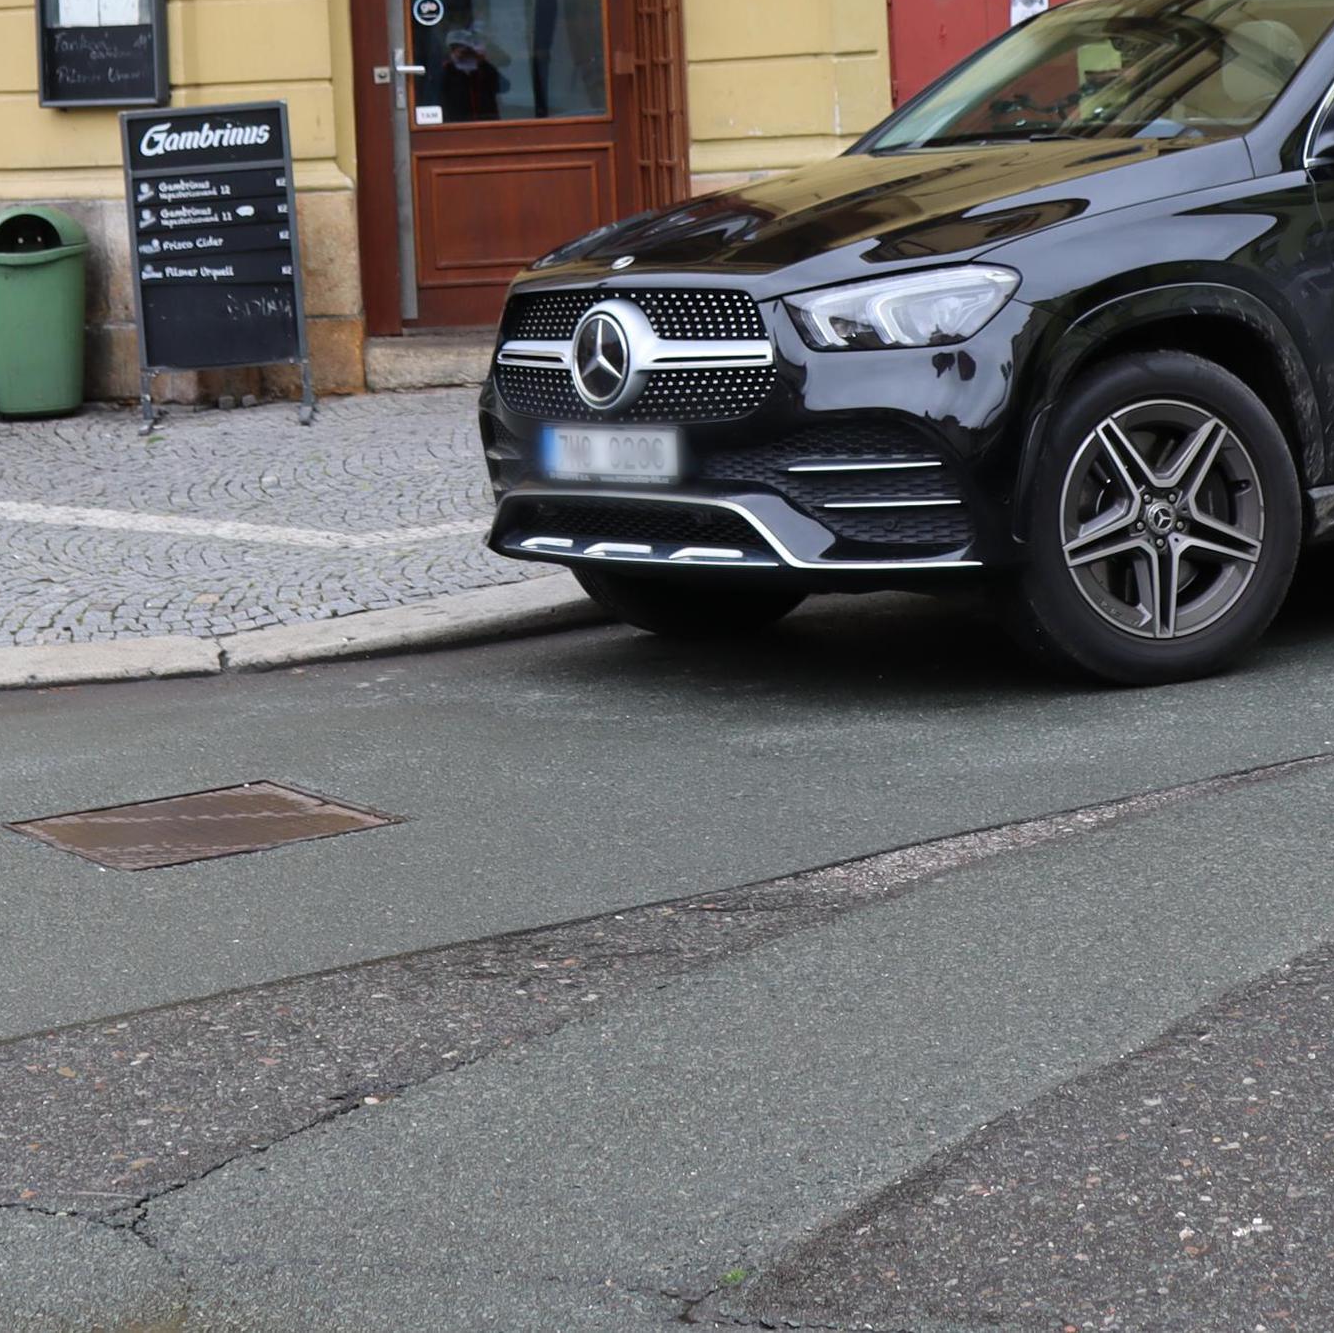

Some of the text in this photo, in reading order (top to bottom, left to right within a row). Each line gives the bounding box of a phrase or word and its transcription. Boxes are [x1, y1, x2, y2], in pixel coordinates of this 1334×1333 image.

[140, 122, 271, 157] Gambrinus
[158, 179, 210, 192] Gambrinus
[160, 205, 212, 218] Gambrinus
[163, 238, 193, 252] Frisco
[196, 235, 224, 249] Cider
[165, 265, 234, 281] Pilsner Urquell
